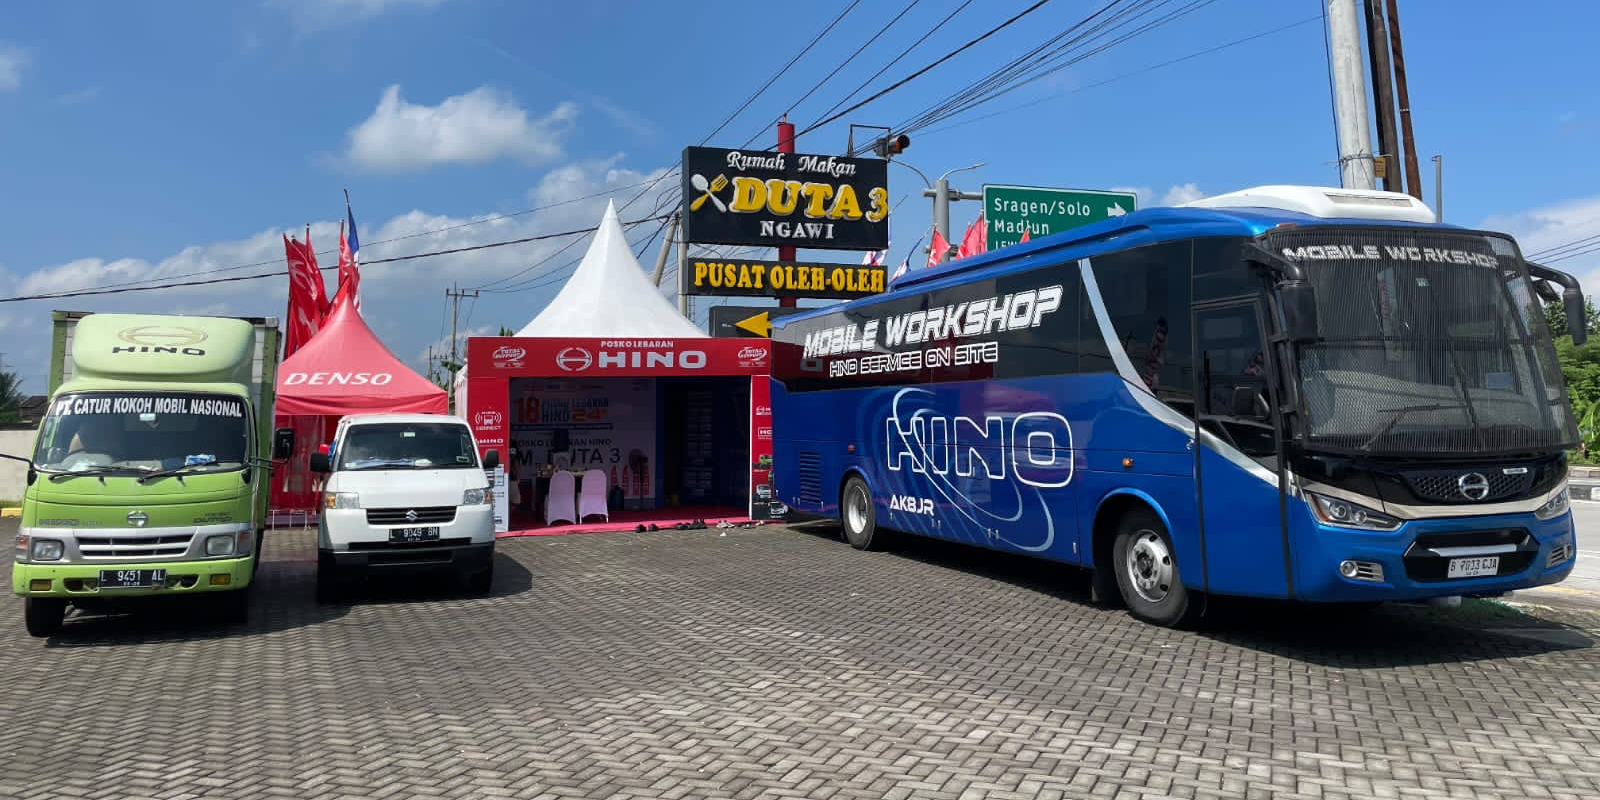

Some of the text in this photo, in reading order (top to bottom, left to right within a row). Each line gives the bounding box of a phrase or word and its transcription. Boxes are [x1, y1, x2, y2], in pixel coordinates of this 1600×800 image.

[727, 152, 857, 178] Rumah Makan
[728, 176, 889, 223] DUTA 3
[994, 198, 1091, 218] Sragen/Solo
[759, 221, 835, 240] NGAWI
[1282, 244, 1500, 269] MOBILE WORKSHOP
[694, 262, 885, 293] PUSAT OLEH-OLEH
[803, 284, 1064, 360] MOBILE WORKSHOP
[112, 346, 206, 356] HINO
[598, 350, 707, 369] HINO
[829, 341, 999, 377] HINO SERVICE ON SITE
[284, 372, 392, 386] DENSO
[74, 398, 111, 415] CATUR
[113, 397, 151, 414] KOKOH
[154, 398, 188, 414] MOBIL
[190, 400, 243, 418] NASIONAL
[886, 412, 1074, 488] HINO
[101, 569, 164, 582] L 9451 AL
